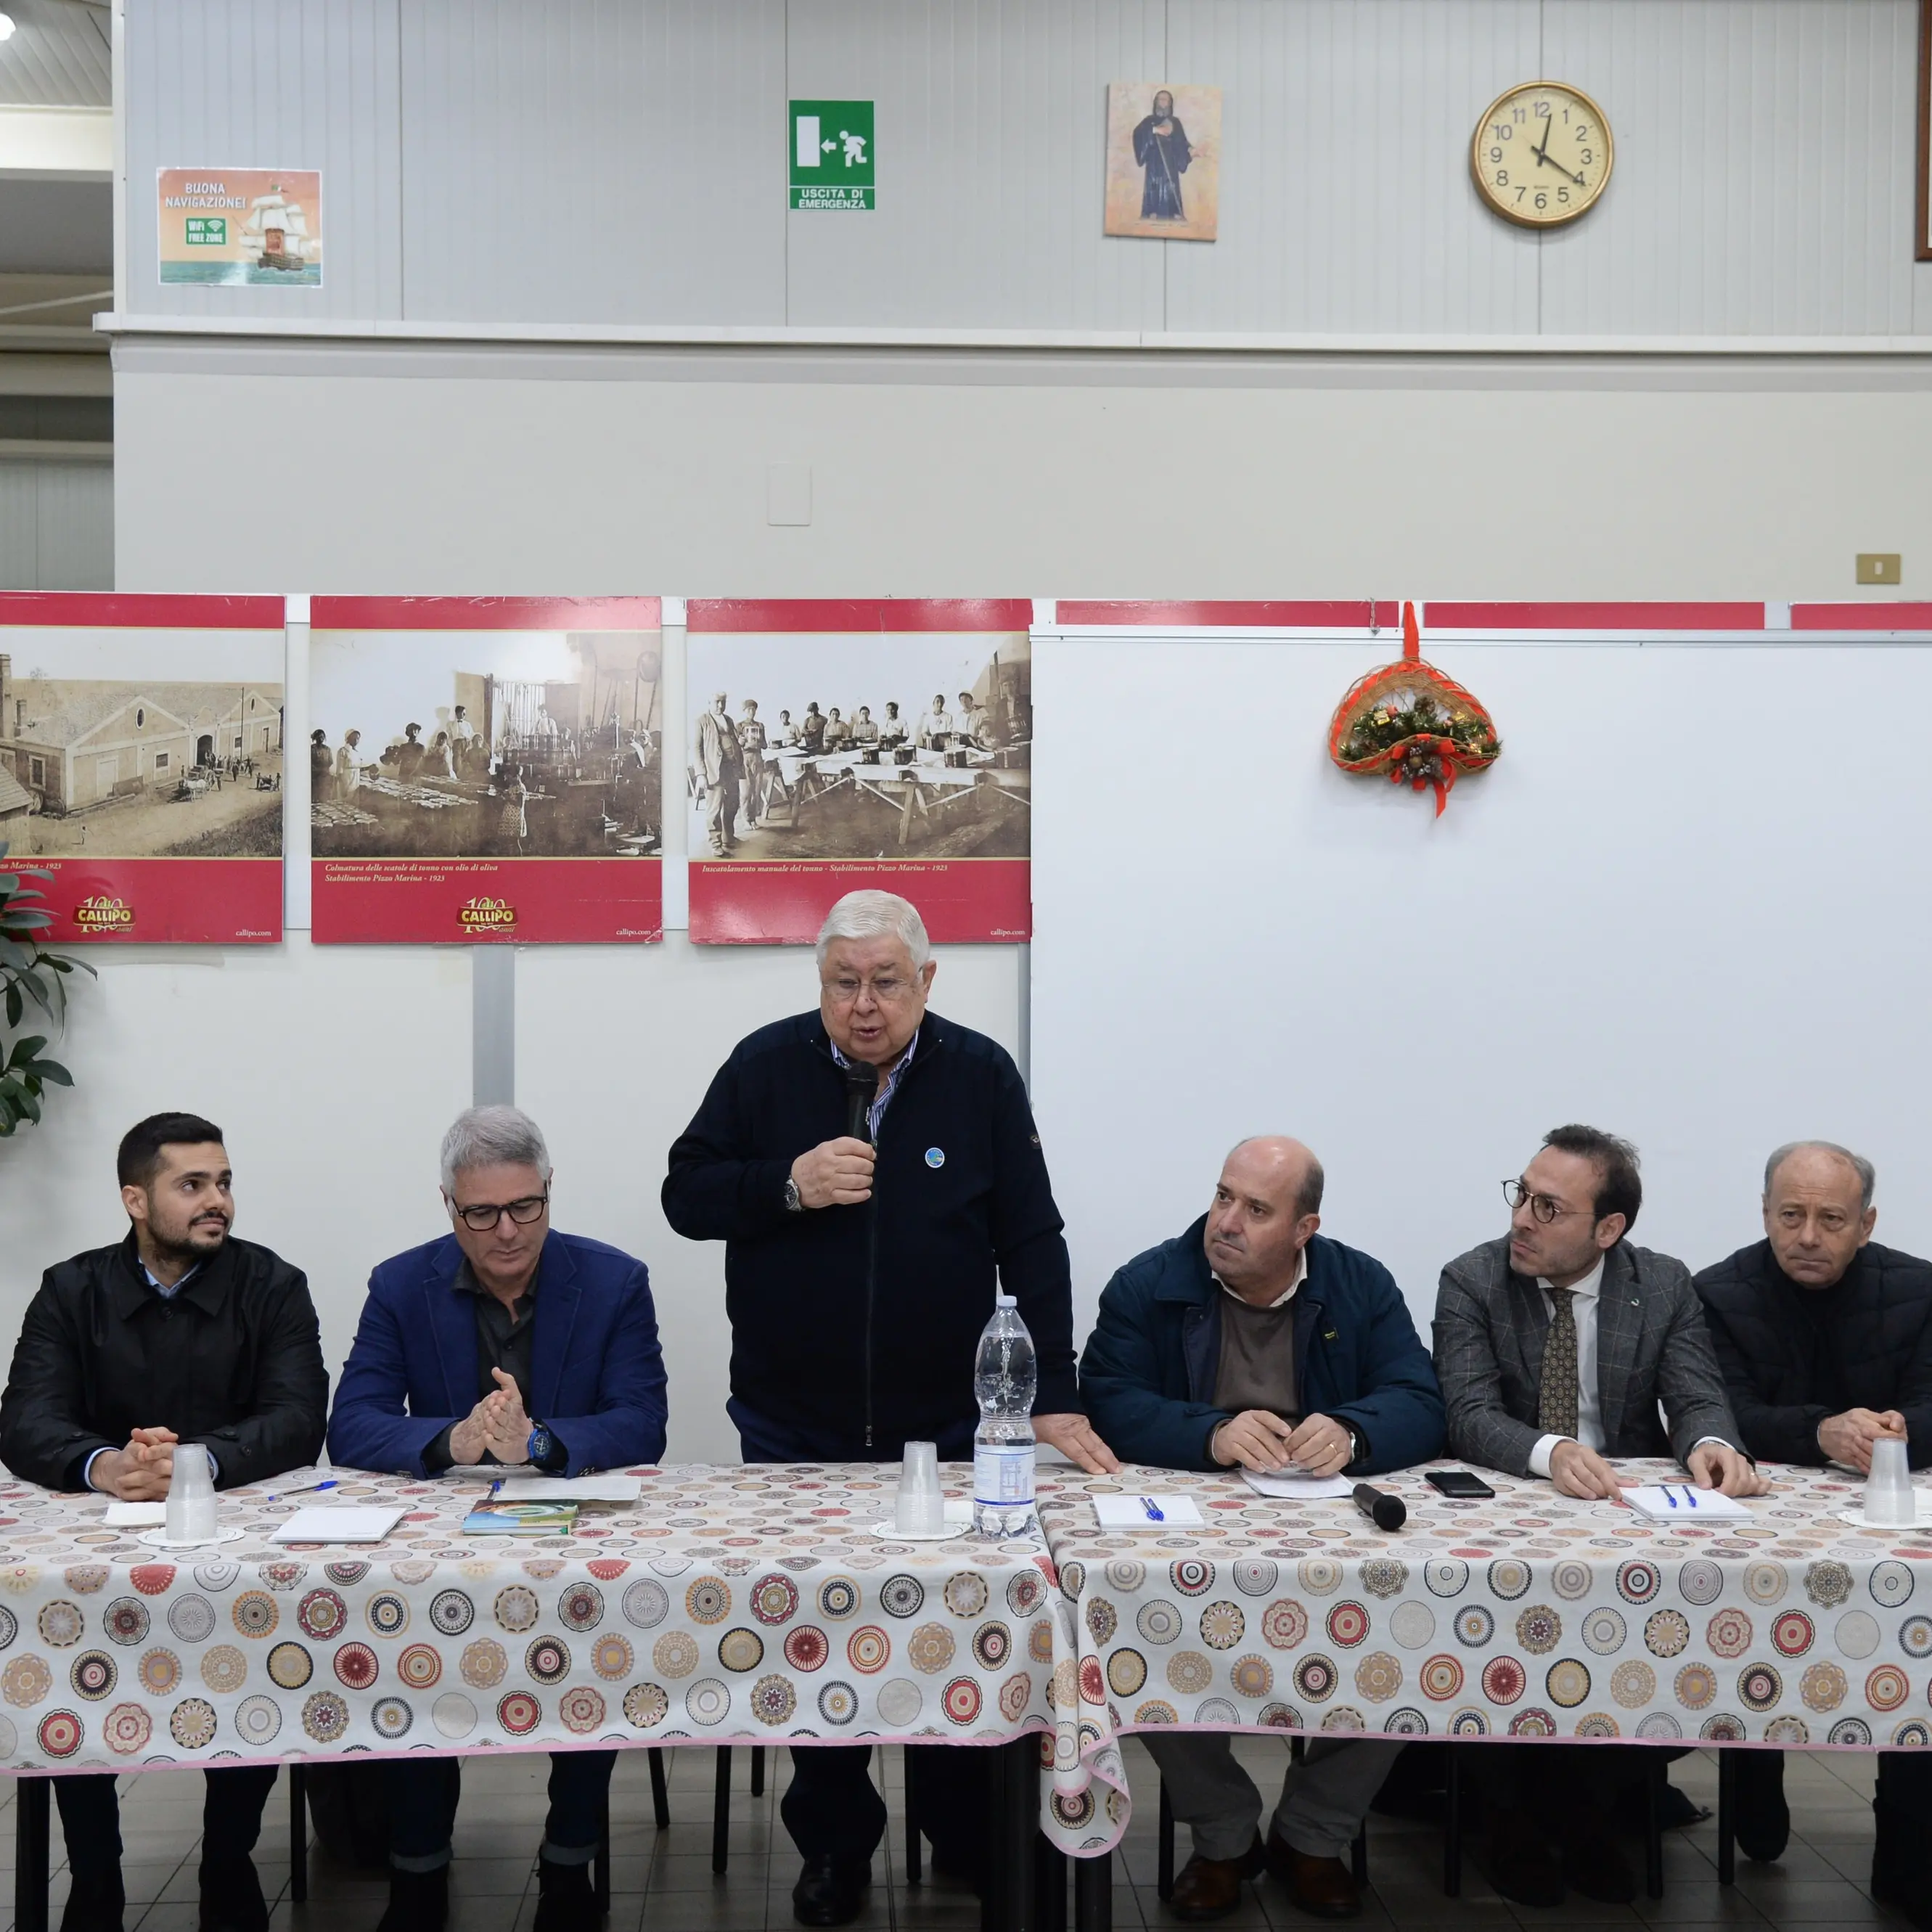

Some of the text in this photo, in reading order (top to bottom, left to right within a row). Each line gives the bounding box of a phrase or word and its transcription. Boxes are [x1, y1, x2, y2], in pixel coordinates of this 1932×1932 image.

[1512, 107, 1526, 124] 11
[1533, 102, 1550, 118] 12
[1563, 108, 1568, 124] 1
[1494, 124, 1513, 141] 10
[1576, 125, 1587, 142] 2
[1490, 147, 1502, 163] 9
[1580, 148, 1592, 165] 3
[1496, 169, 1509, 187] 8
[185, 182, 226, 195] BUONA
[801, 189, 864, 199] USCITA DI
[1514, 186, 1526, 202] 7
[1557, 186, 1570, 203] 5
[165, 197, 247, 209] NAVIGAZIONE!
[798, 199, 867, 209] EMERGENZA
[1534, 192, 1547, 210] 6
[188, 233, 224, 244] FREE ZONE
[10, 861, 39, 869] Marina
[324, 874, 371, 883] Stabilimento
[78, 909, 131, 922] CALLIPO
[461, 909, 514, 922] CALLIPO
[235, 928, 272, 938] callipo.com
[615, 928, 652, 937] callipo.com
[990, 928, 1026, 937] callipo.com
